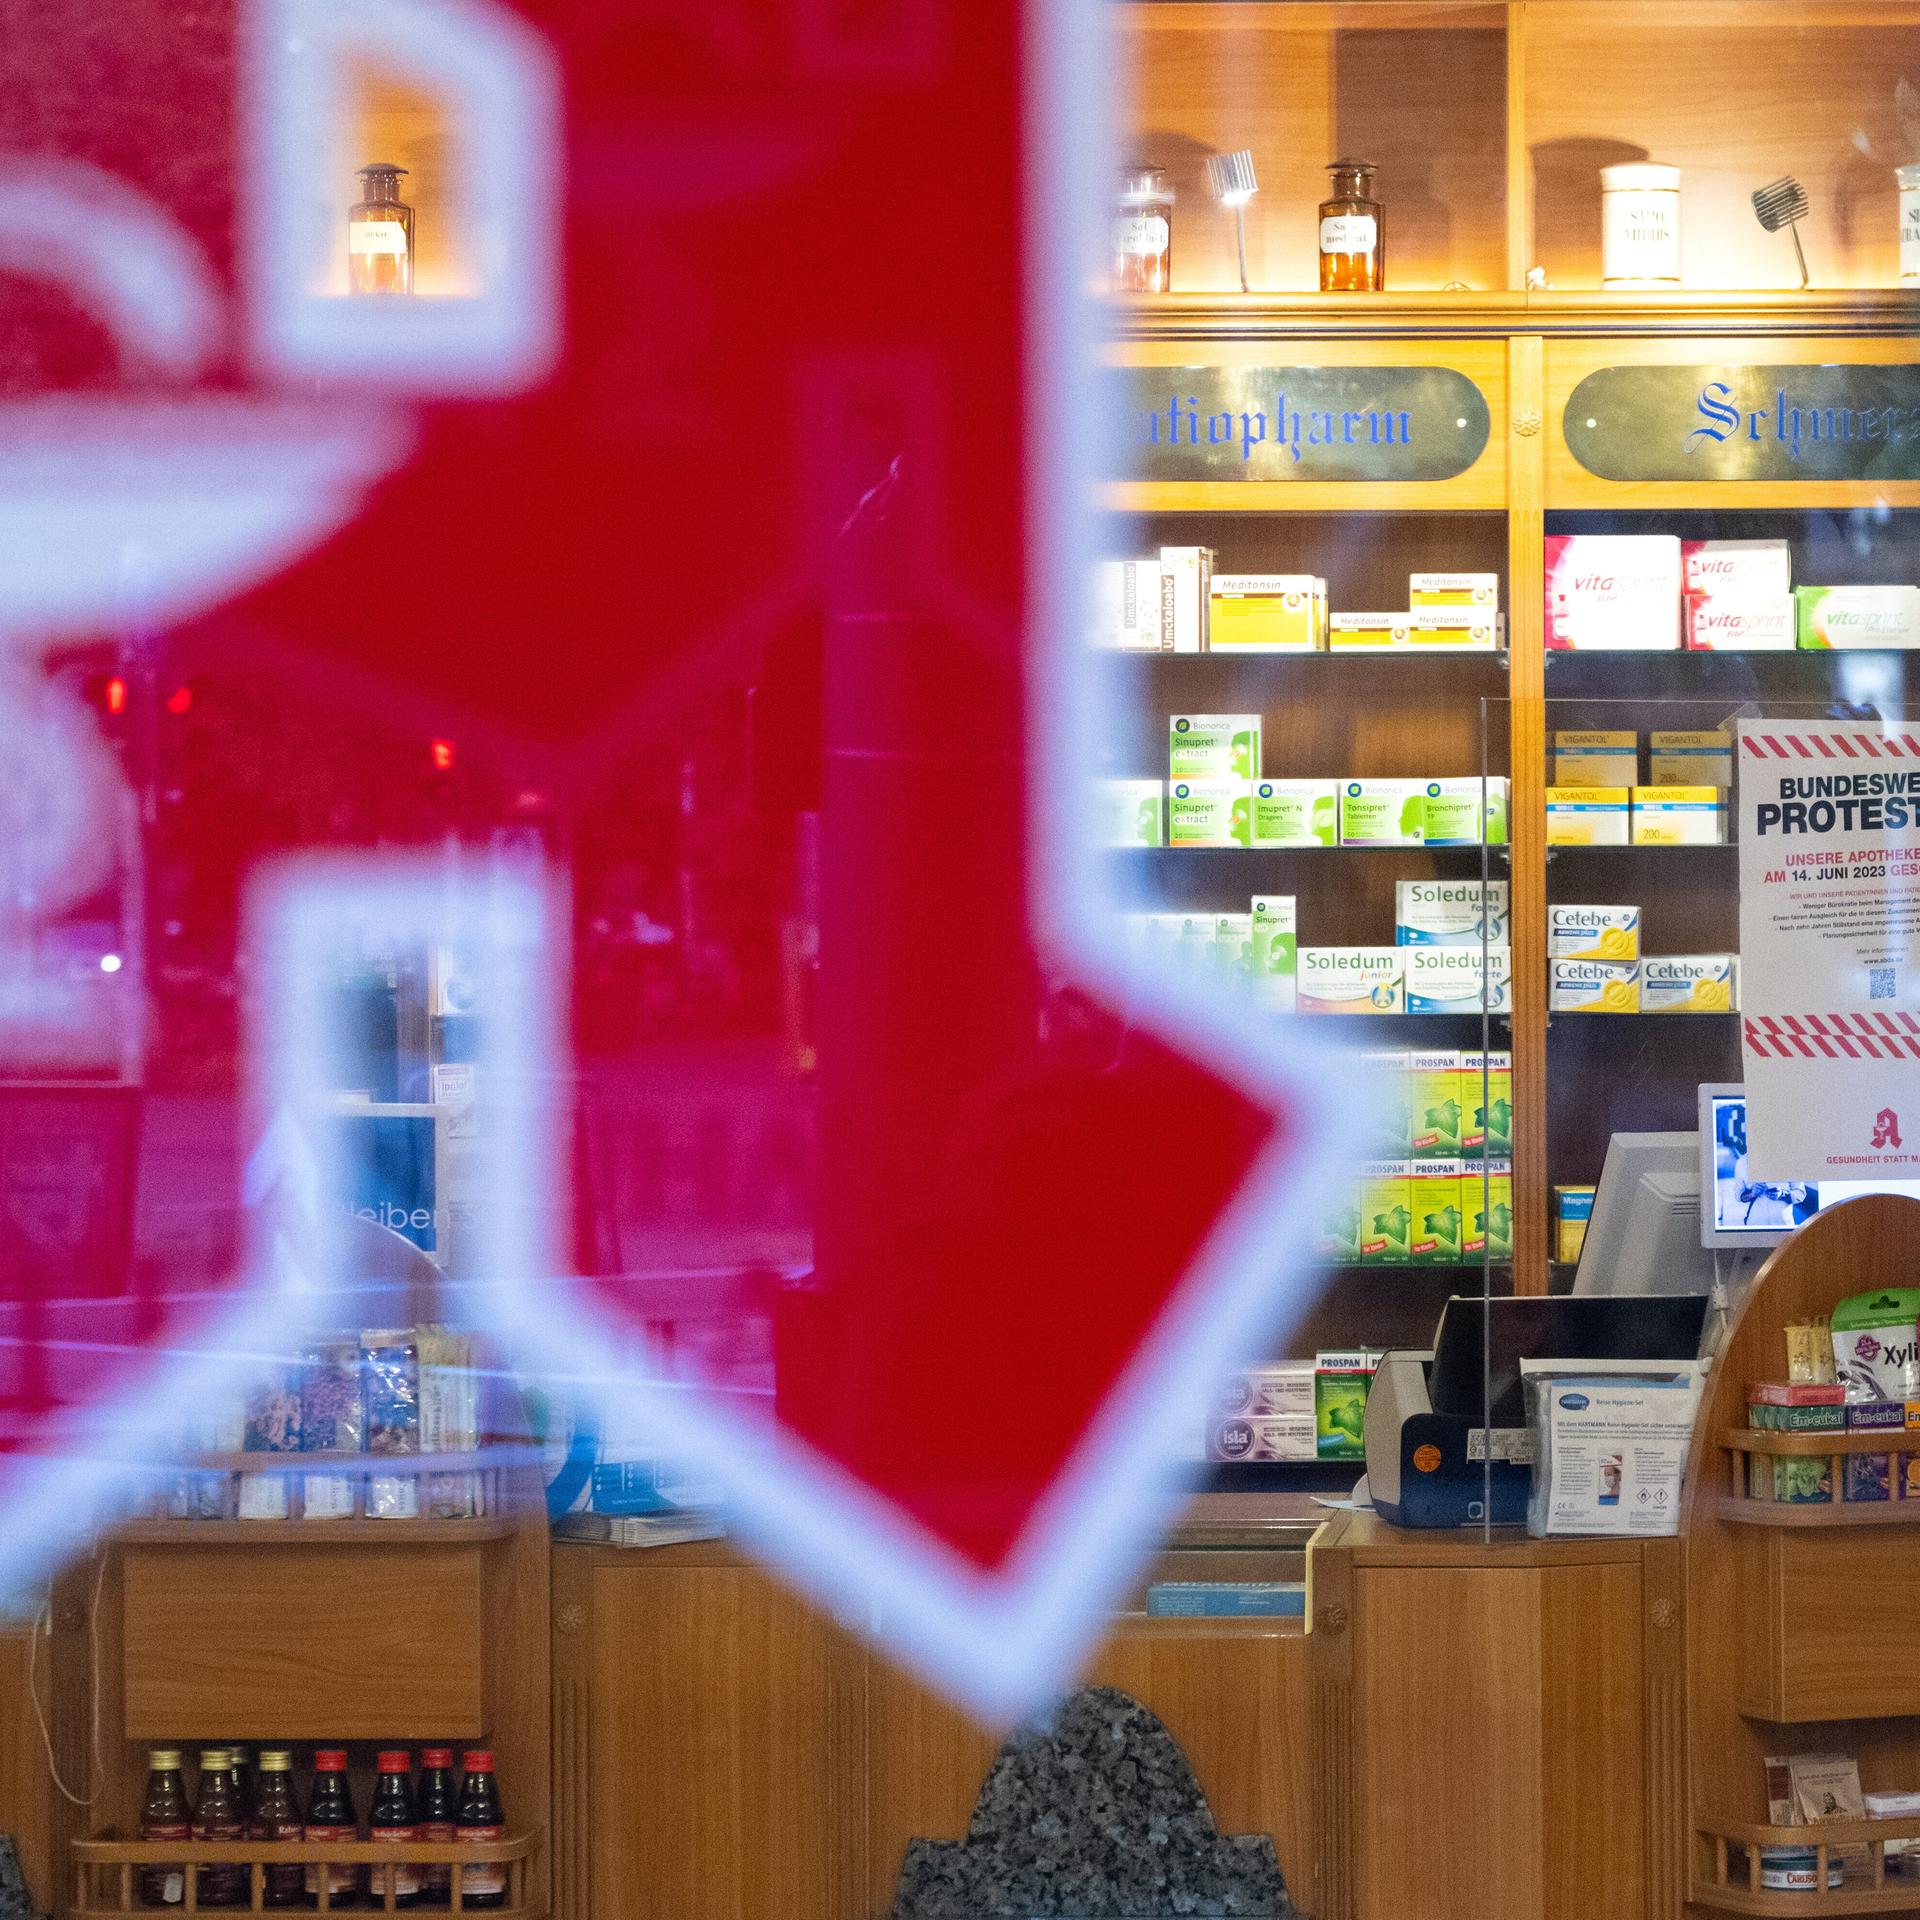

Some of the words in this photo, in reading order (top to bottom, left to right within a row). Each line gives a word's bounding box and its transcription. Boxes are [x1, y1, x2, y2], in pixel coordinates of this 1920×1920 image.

[1138, 391, 1413, 463] atiopharm
[1221, 579, 1282, 590] Meditonsin
[1421, 578, 1471, 586] Meditonsin
[1126, 565, 1137, 626] Umckaloabo
[1162, 577, 1175, 649] Umckaloabo
[1340, 617, 1390, 625] Meditonsin
[1418, 616, 1468, 624] Meditonsin
[1193, 722, 1231, 731] Bionorica
[1174, 738, 1215, 748] Sinupret
[1564, 735, 1607, 744] VIGANTOL
[1660, 735, 1703, 744] VIGANTOL
[1174, 750, 1209, 758] extract
[1660, 773, 1677, 784] 200
[1555, 791, 1599, 801] VIGANTOL
[1643, 791, 1686, 800] VIGANTOL
[1174, 804, 1215, 813] Sinupret
[1257, 805, 1292, 814] Imupret
[1347, 804, 1387, 813] Tonsipret
[1426, 803, 1472, 813] Bronchipret
[1174, 815, 1209, 823] extract
[1642, 829, 1660, 840] 200
[1785, 851, 1844, 867] UNSERE
[1764, 871, 1786, 884] AM
[1791, 869, 1812, 882] 14.
[1816, 866, 1849, 881] JUNI
[1853, 865, 1886, 879] 2023
[1411, 886, 1500, 902] Soledum
[1803, 892, 1818, 900] UND
[1818, 890, 1844, 899] UNSERE
[1471, 903, 1500, 913] fote
[1802, 902, 1827, 911] Weniger
[1827, 900, 1858, 909] Bürokratie
[1255, 916, 1288, 924] Sinupret
[1552, 909, 1612, 927] Cetebe
[1772, 914, 1790, 922] Einen
[1808, 912, 1838, 922] Ausgleich
[1838, 911, 1848, 919] für
[1865, 909, 1887, 917] diesem
[1306, 953, 1394, 969] Soledum
[1414, 952, 1502, 969] Soledum
[1360, 970, 1393, 981] junior
[1473, 969, 1502, 978] fote
[1555, 963, 1614, 980] Cetebe
[1646, 962, 1704, 979] Cetebe
[1415, 1058, 1455, 1067] PROSPAN
[1826, 1155, 1881, 1165] GESUNDHEIT
[1883, 1154, 1909, 1164] STATT
[1415, 1164, 1455, 1174] PROSPAN
[351, 1201, 450, 1230] leiben
[1321, 1358, 1361, 1367] PROSPAN
[1223, 1430, 1248, 1445] isla
